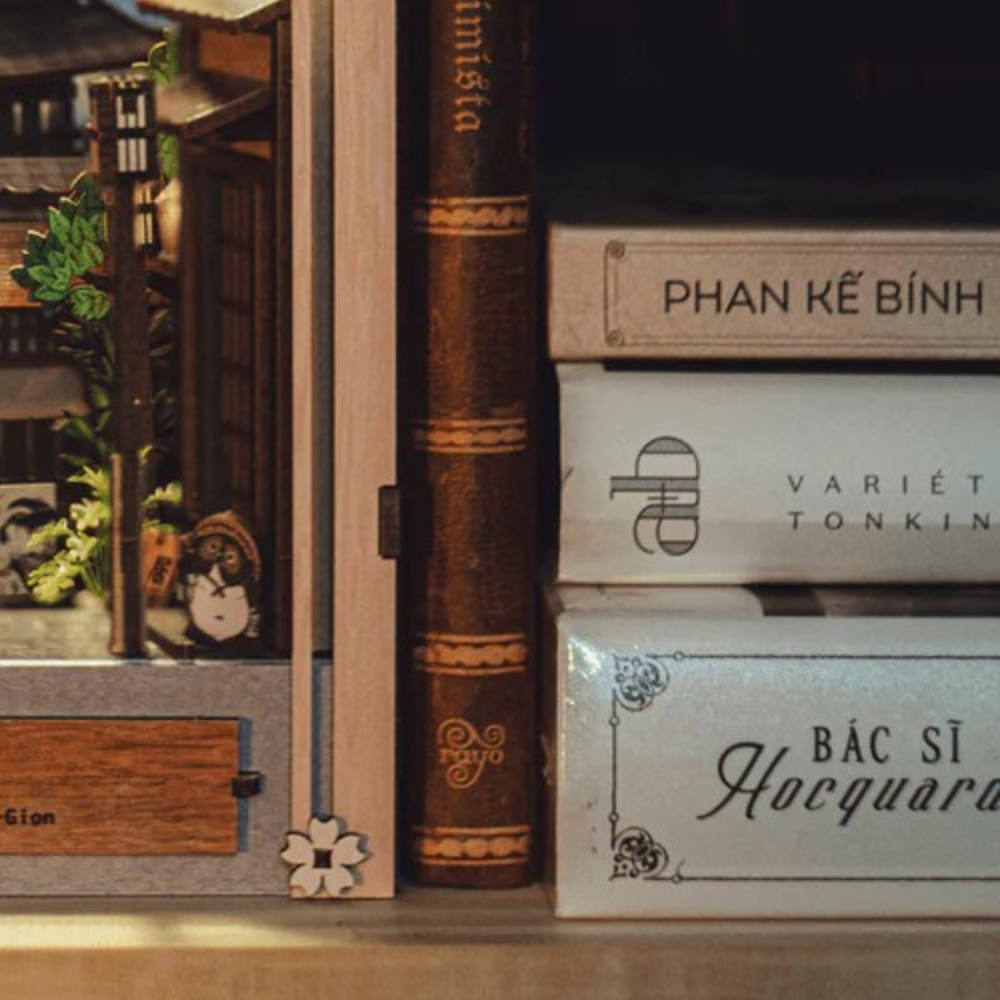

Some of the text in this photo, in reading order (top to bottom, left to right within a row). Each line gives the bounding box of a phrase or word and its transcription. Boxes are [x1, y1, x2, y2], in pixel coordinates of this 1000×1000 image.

[664, 279, 789, 314] PHAN
[876, 270, 984, 315] BÍNH
[787, 469, 985, 495] VARIÉT
[787, 511, 991, 531] TONKIN
[812, 718, 963, 764] BÁC SĨ
